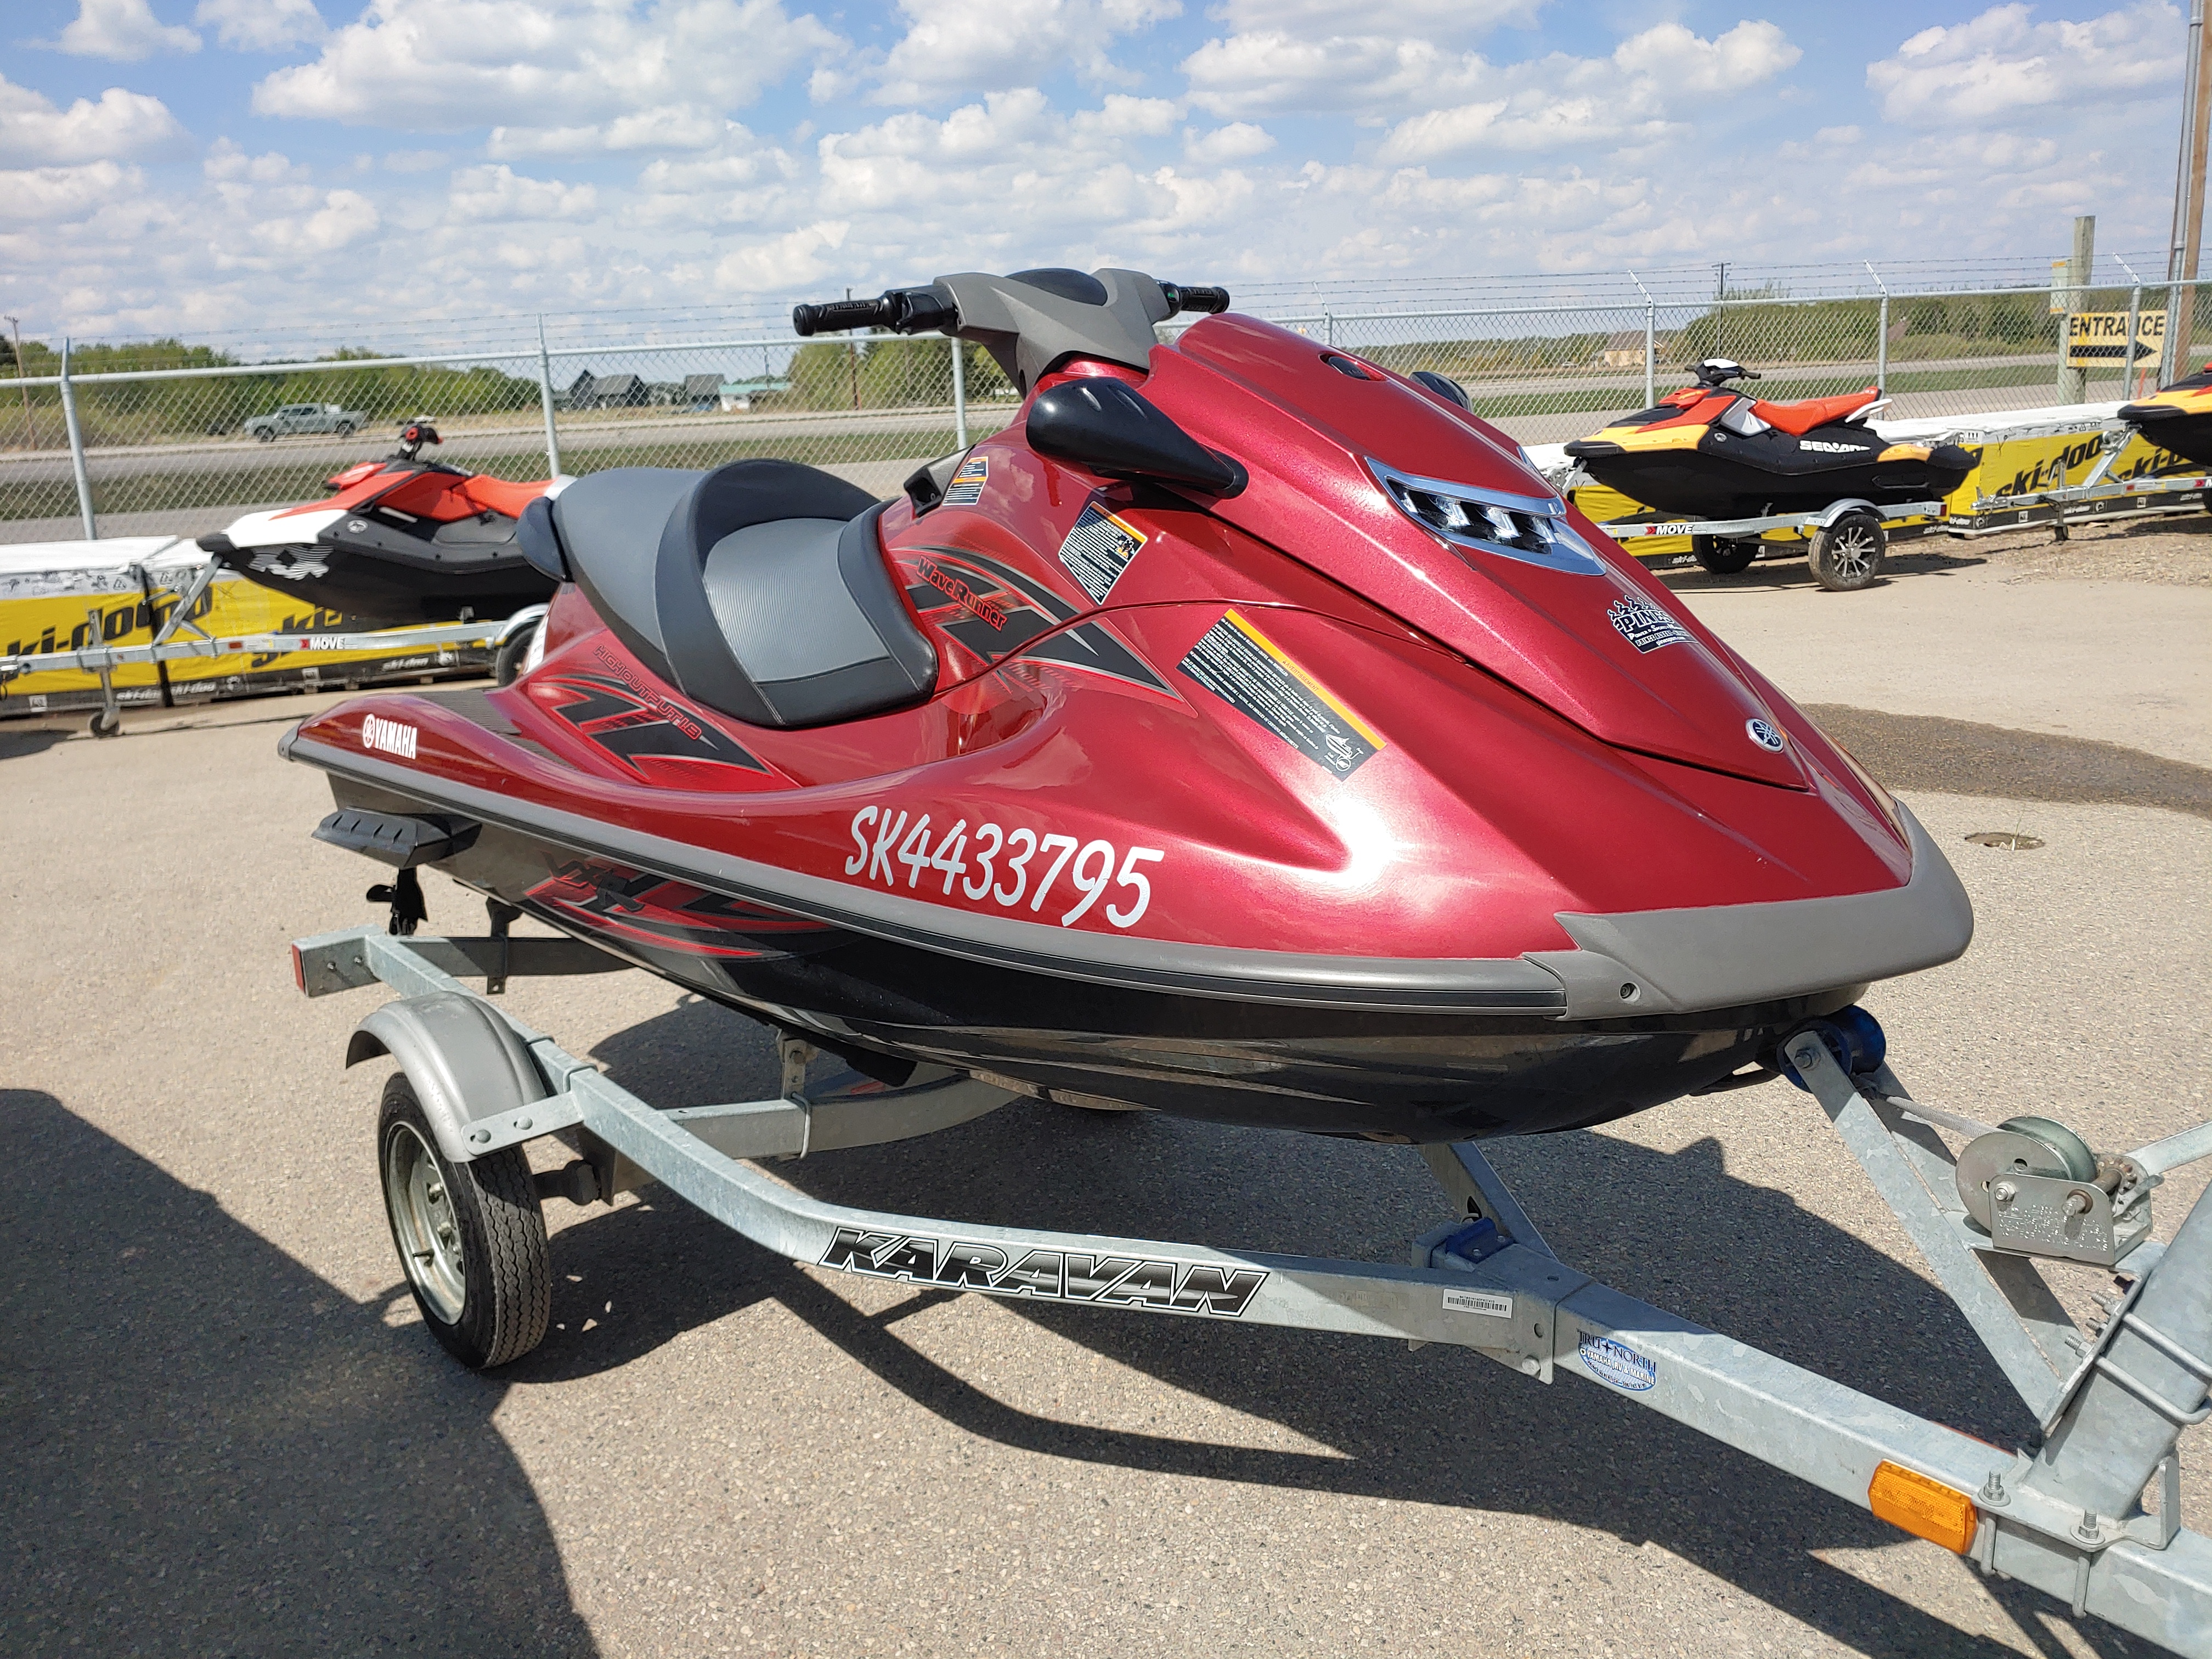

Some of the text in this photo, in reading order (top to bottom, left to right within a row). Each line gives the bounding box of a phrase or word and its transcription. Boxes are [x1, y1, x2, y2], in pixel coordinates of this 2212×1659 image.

[1656, 524, 1693, 535] MOVE
[916, 555, 1008, 631] WaveRunner
[1620, 610, 1674, 633] PINES
[310, 636, 345, 650] MOVE
[1635, 634, 1657, 646] PRINCE
[375, 718, 417, 760] YAMAHA
[845, 805, 1165, 928] SK4433795
[818, 1226, 1270, 1317] KARAVAN
[1576, 1328, 1658, 1373] TRU NORTH
[1629, 1368, 1655, 1385] MARINE
